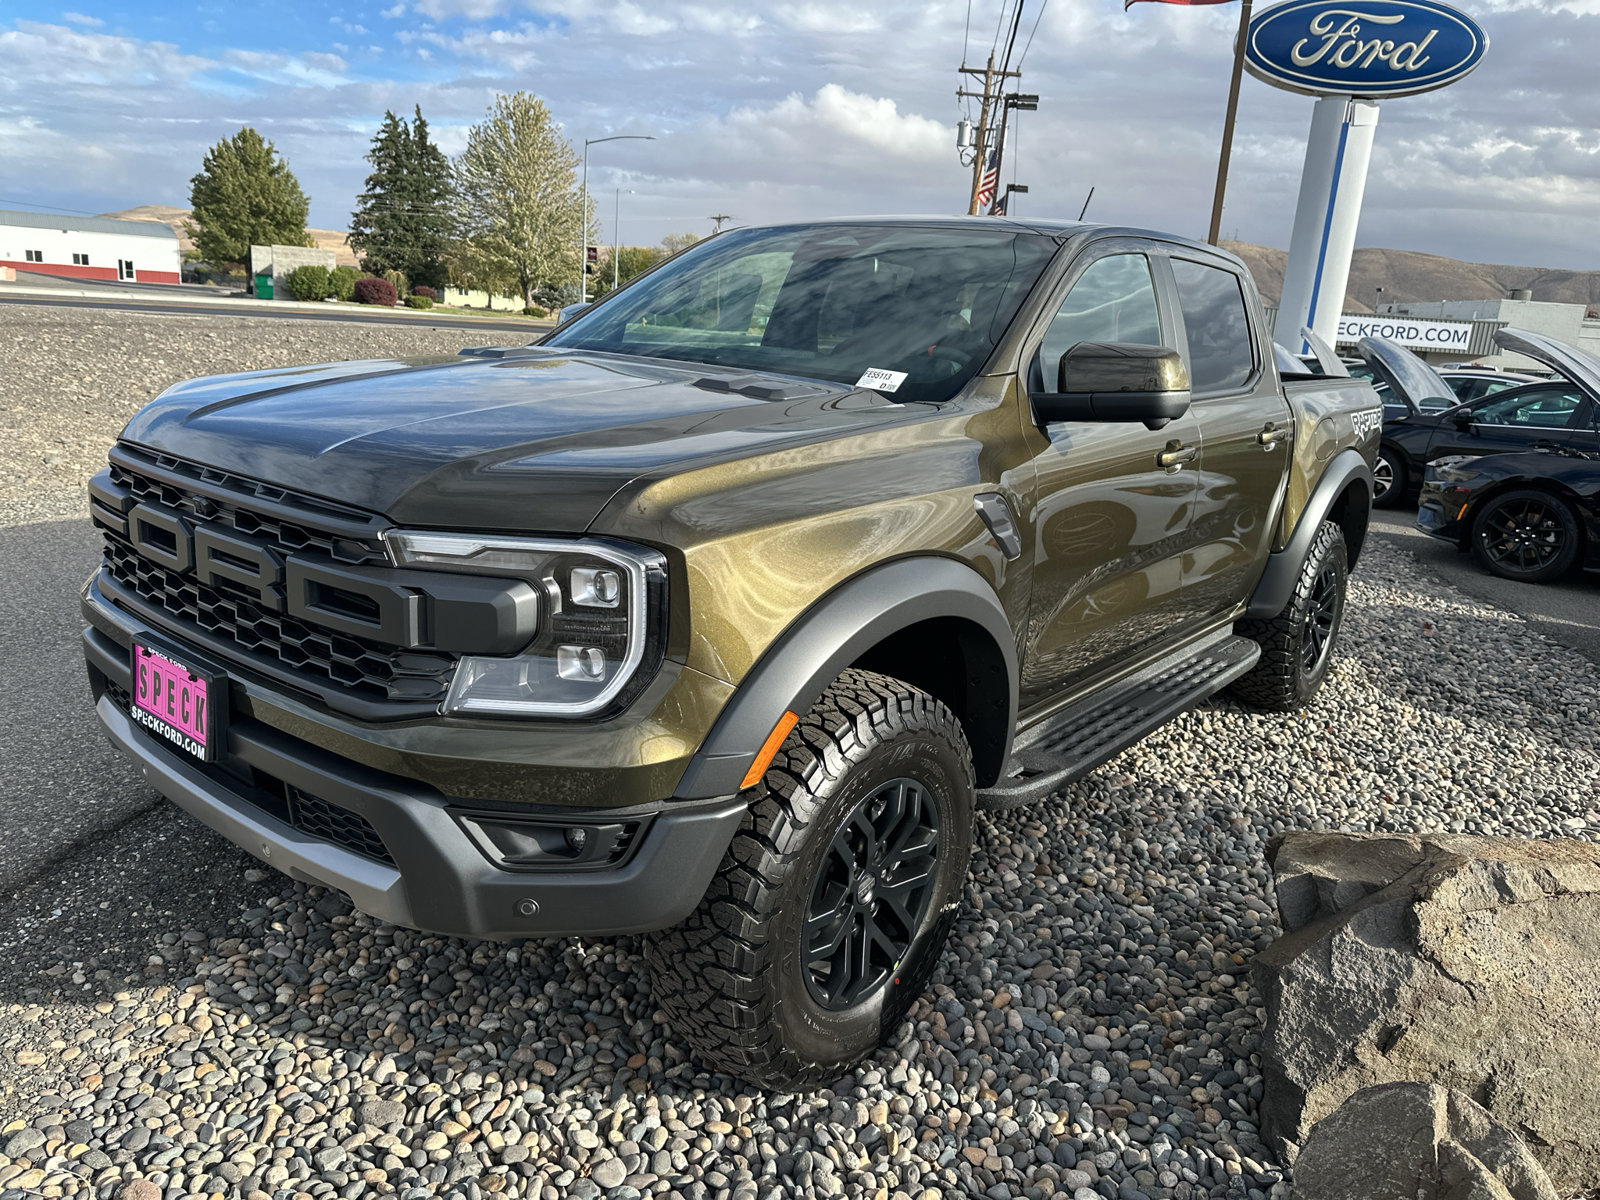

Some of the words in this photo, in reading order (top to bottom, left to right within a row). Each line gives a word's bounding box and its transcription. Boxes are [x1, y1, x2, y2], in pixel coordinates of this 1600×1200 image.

[1290, 9, 1439, 72] Ford
[139, 663, 206, 736] SPECK
[131, 705, 205, 761] SPECKFORD.COM
